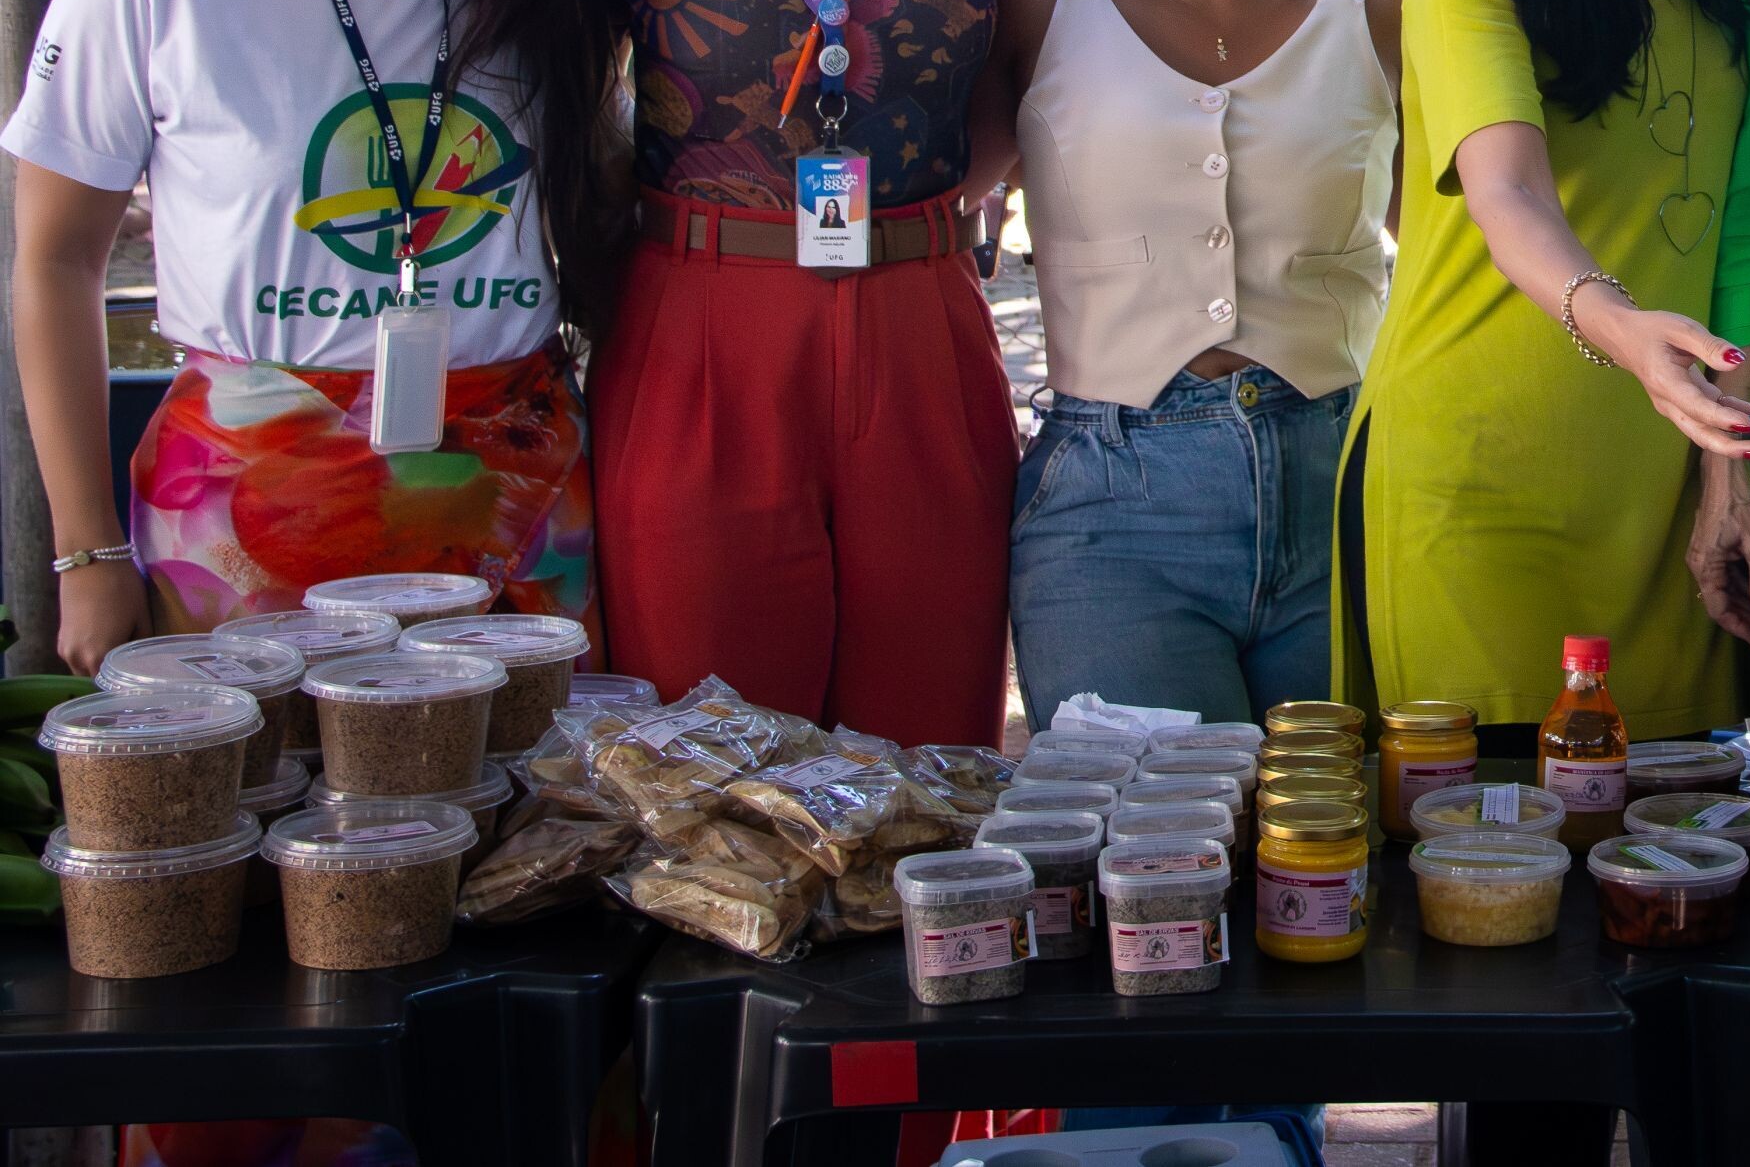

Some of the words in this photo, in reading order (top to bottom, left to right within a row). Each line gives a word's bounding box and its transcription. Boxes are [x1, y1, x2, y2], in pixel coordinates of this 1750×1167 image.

[359, 59, 375, 82] UFG
[431, 92, 443, 115] UFG
[385, 124, 400, 150] UFG
[453, 277, 541, 310] UFG
